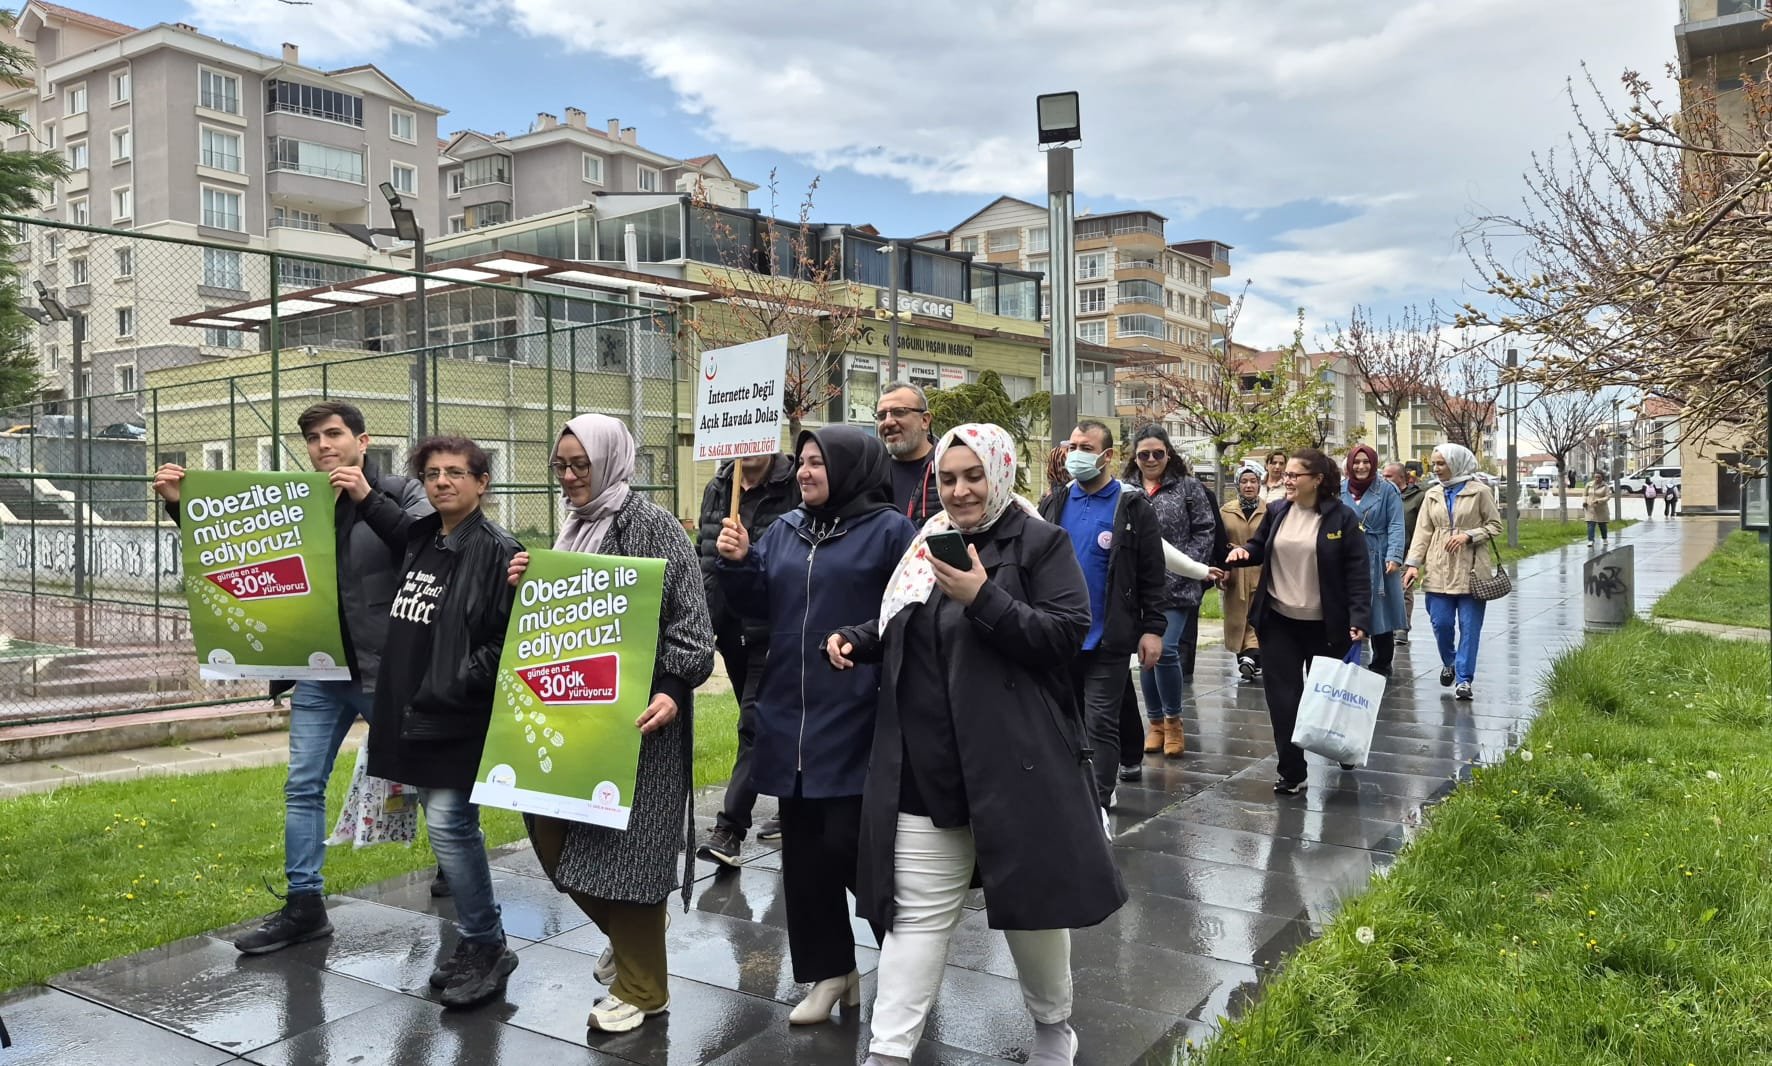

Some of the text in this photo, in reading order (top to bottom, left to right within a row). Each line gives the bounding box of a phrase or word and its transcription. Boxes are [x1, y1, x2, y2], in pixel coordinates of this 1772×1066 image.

[922, 301, 952, 317] CAFE
[898, 335, 924, 350] SAĞLIKLI
[926, 341, 946, 356] YAŞAM
[708, 380, 775, 405] İnternette Değil
[700, 407, 778, 433] Açık Havada Dolaş
[700, 437, 775, 457] İL SAĞLIK MÜDÜRLÜĞÜ
[187, 481, 310, 522] Obezite ile
[193, 504, 304, 545] mücadele
[200, 526, 303, 566] ediyoruz!
[217, 570, 240, 581] günde
[520, 566, 638, 607] Obezite ile
[262, 582, 305, 595] yürüyoruz
[390, 588, 435, 624] erfec
[518, 594, 629, 634] mücadele
[518, 619, 623, 660] ediyoruz!
[527, 667, 550, 680] günde
[561, 665, 570, 673] az
[568, 686, 613, 698] yürüyoruz
